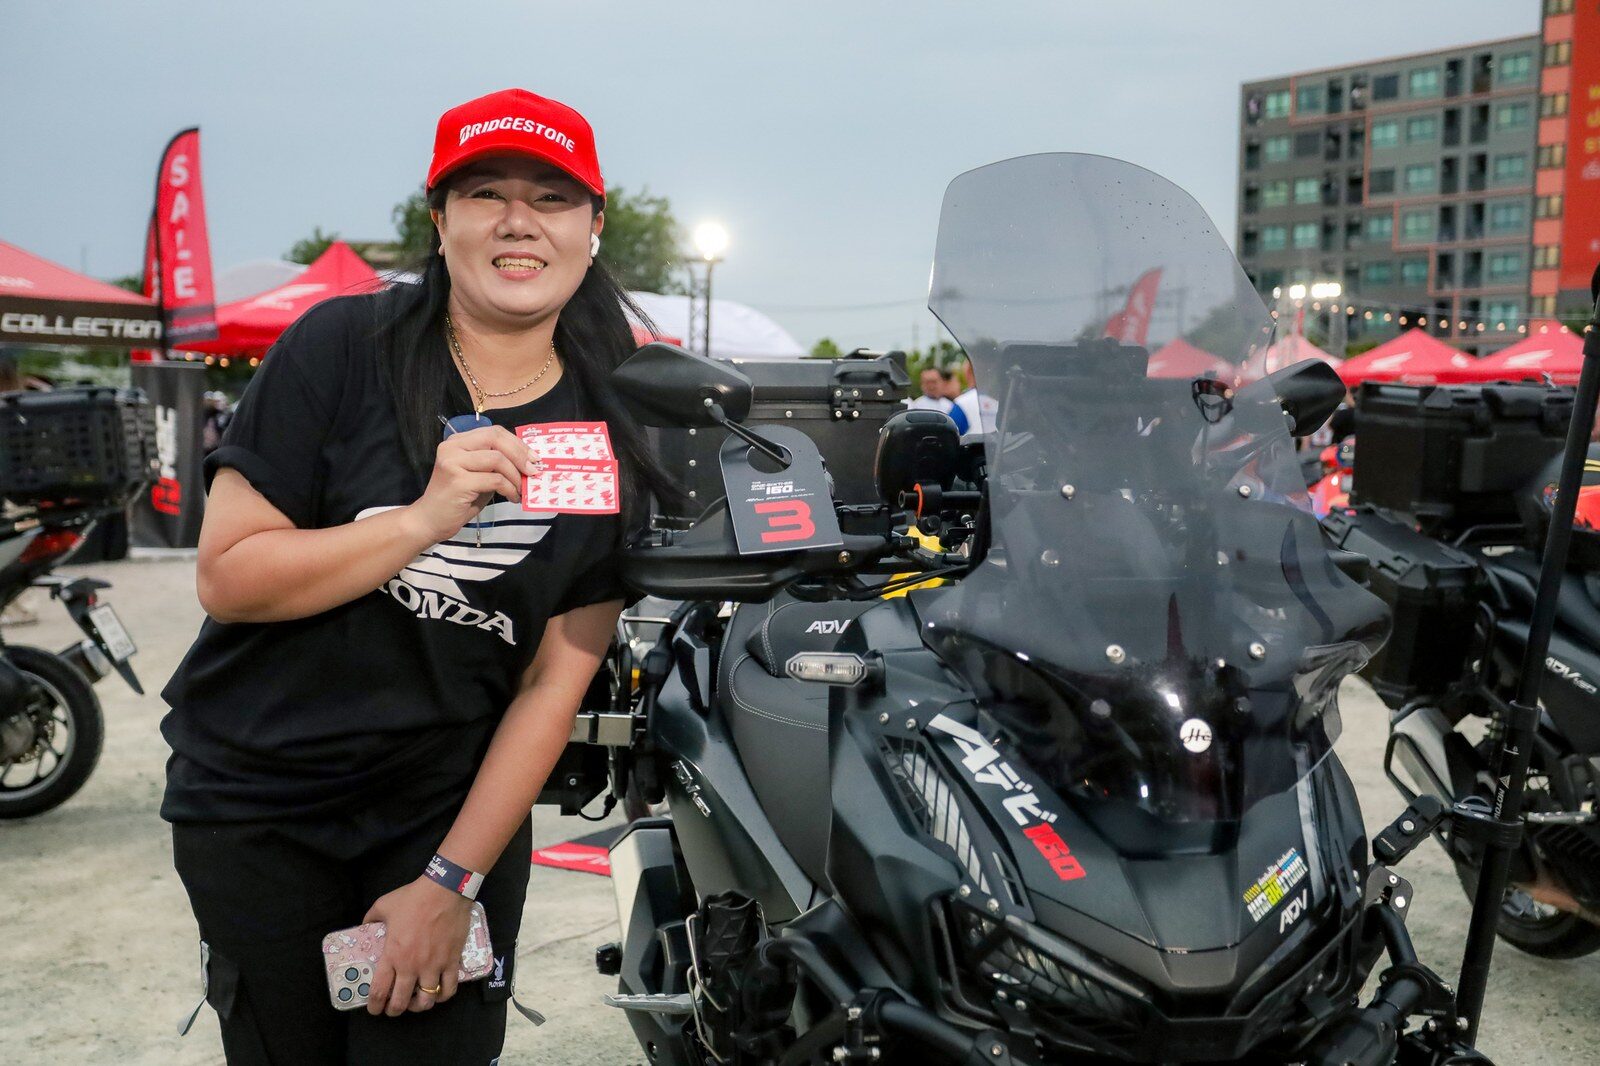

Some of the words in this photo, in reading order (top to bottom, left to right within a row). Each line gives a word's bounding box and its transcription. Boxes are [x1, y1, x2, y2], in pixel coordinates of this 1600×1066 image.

[459, 117, 575, 153] BRIDGESTONE
[169, 154, 197, 299] SALE
[1, 312, 162, 339] COLLECTION
[766, 485, 793, 495] 160
[754, 499, 815, 544] 3
[377, 577, 517, 645] ONDA
[805, 619, 851, 634] ADV
[1279, 888, 1307, 934] ADV
